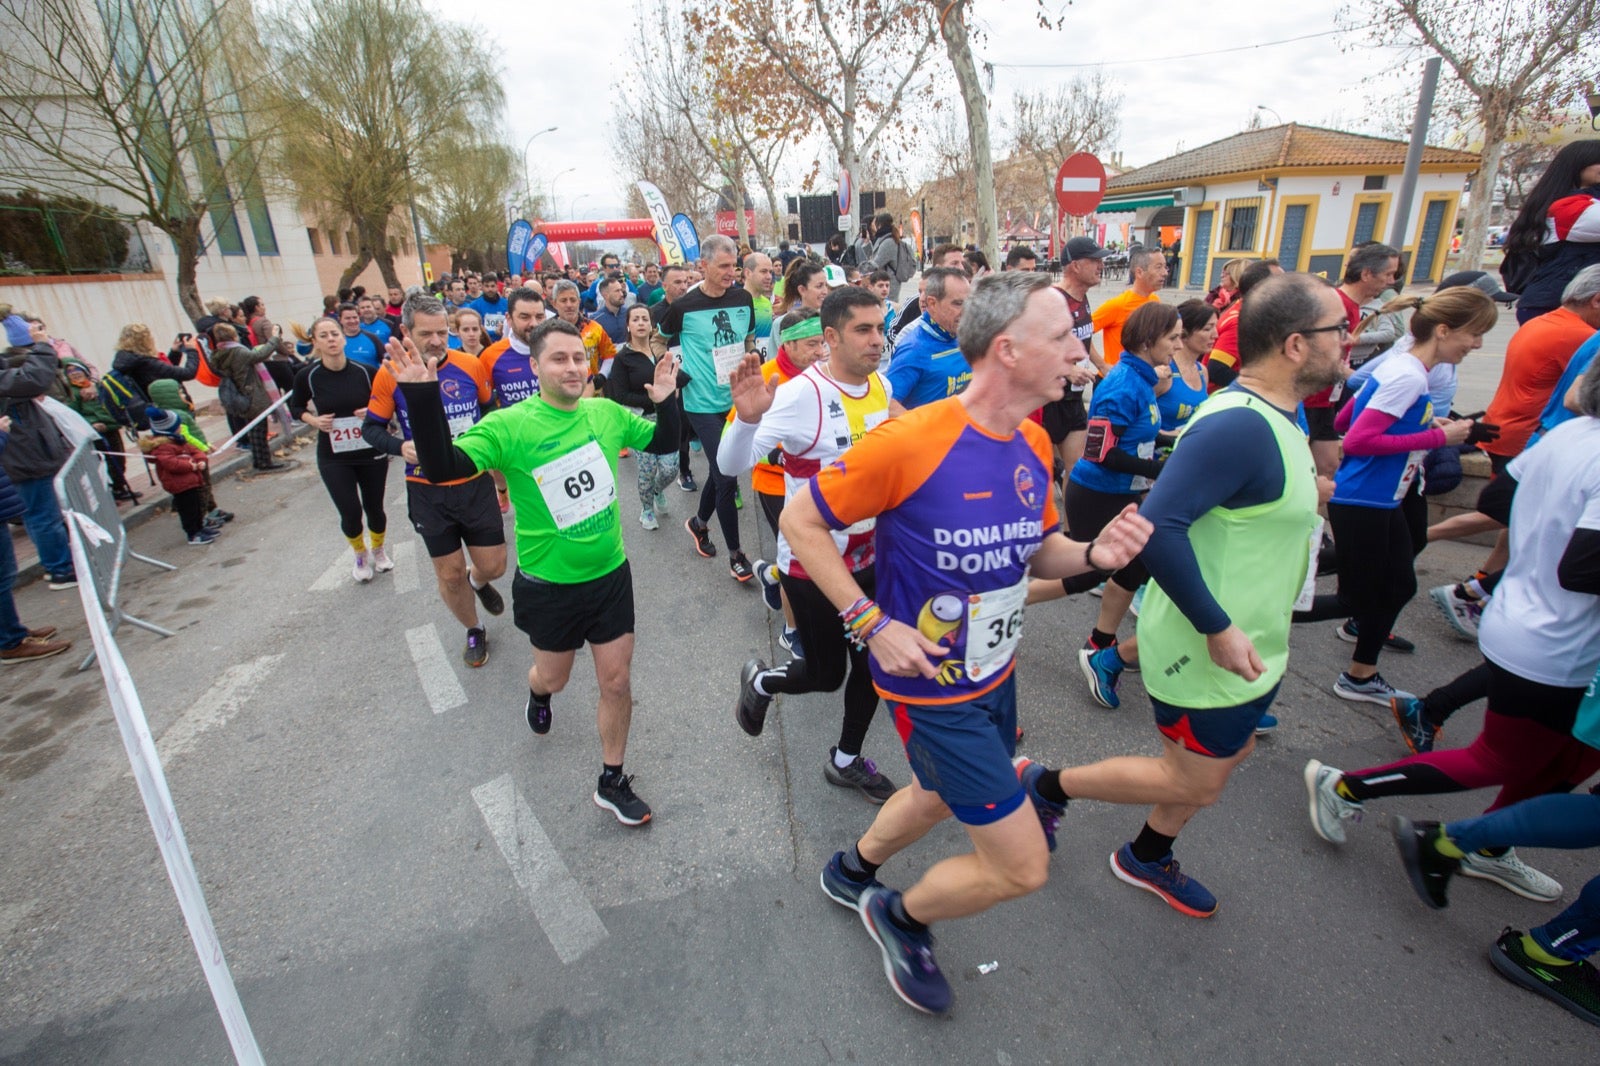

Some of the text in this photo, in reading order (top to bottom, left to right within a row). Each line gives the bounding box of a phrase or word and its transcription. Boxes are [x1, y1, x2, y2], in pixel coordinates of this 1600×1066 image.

[501, 380, 529, 392] DONA
[333, 427, 362, 441] 219
[564, 470, 595, 499] 69
[933, 525, 1002, 548] DONA
[936, 546, 1012, 575] DONA
[987, 608, 1024, 648] 36
